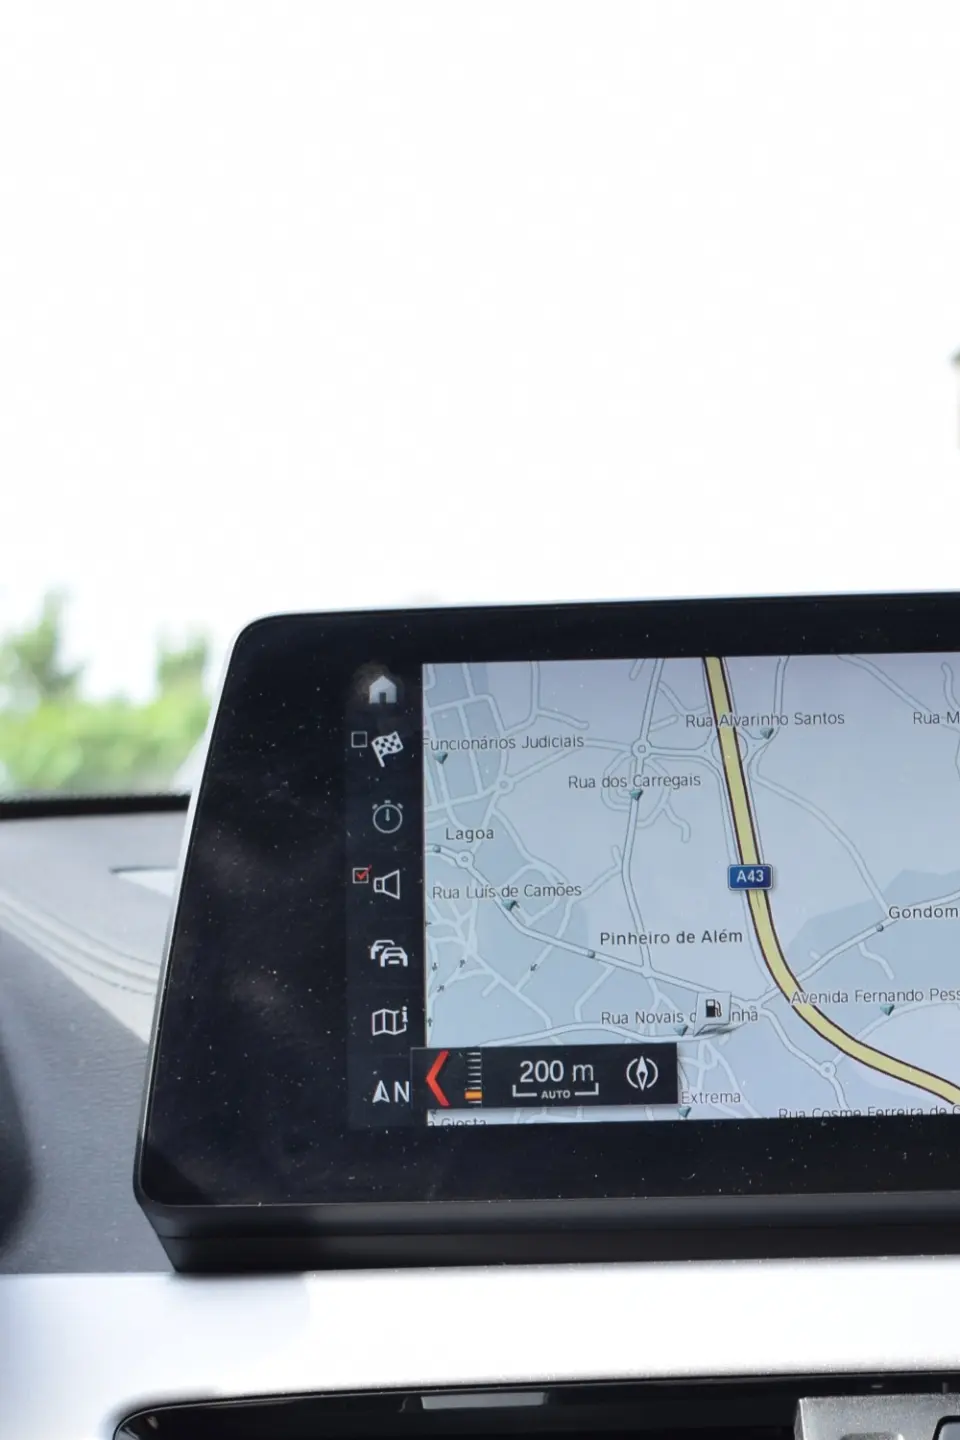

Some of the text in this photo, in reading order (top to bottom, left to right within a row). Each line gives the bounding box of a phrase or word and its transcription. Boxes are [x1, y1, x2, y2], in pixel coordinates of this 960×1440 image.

[685, 711, 845, 728] Rua Alvarinho Santos
[913, 711, 940, 726] Rua
[422, 735, 585, 752] Funcionários Judiciais
[568, 774, 702, 791] Rua dos Carregais
[445, 827, 495, 845] Lagoa
[736, 868, 765, 884] A43
[432, 882, 583, 900] Rua Luís de Camões
[599, 928, 743, 946] Pinheiro de Além
[791, 991, 849, 1005] Avenida
[854, 987, 924, 1003] Fernando
[601, 1011, 629, 1025] Rua
[635, 1010, 684, 1024] Novais
[519, 1060, 595, 1083] 200 m
[541, 1089, 571, 1099] AUTO
[681, 1090, 741, 1104] Extrema
